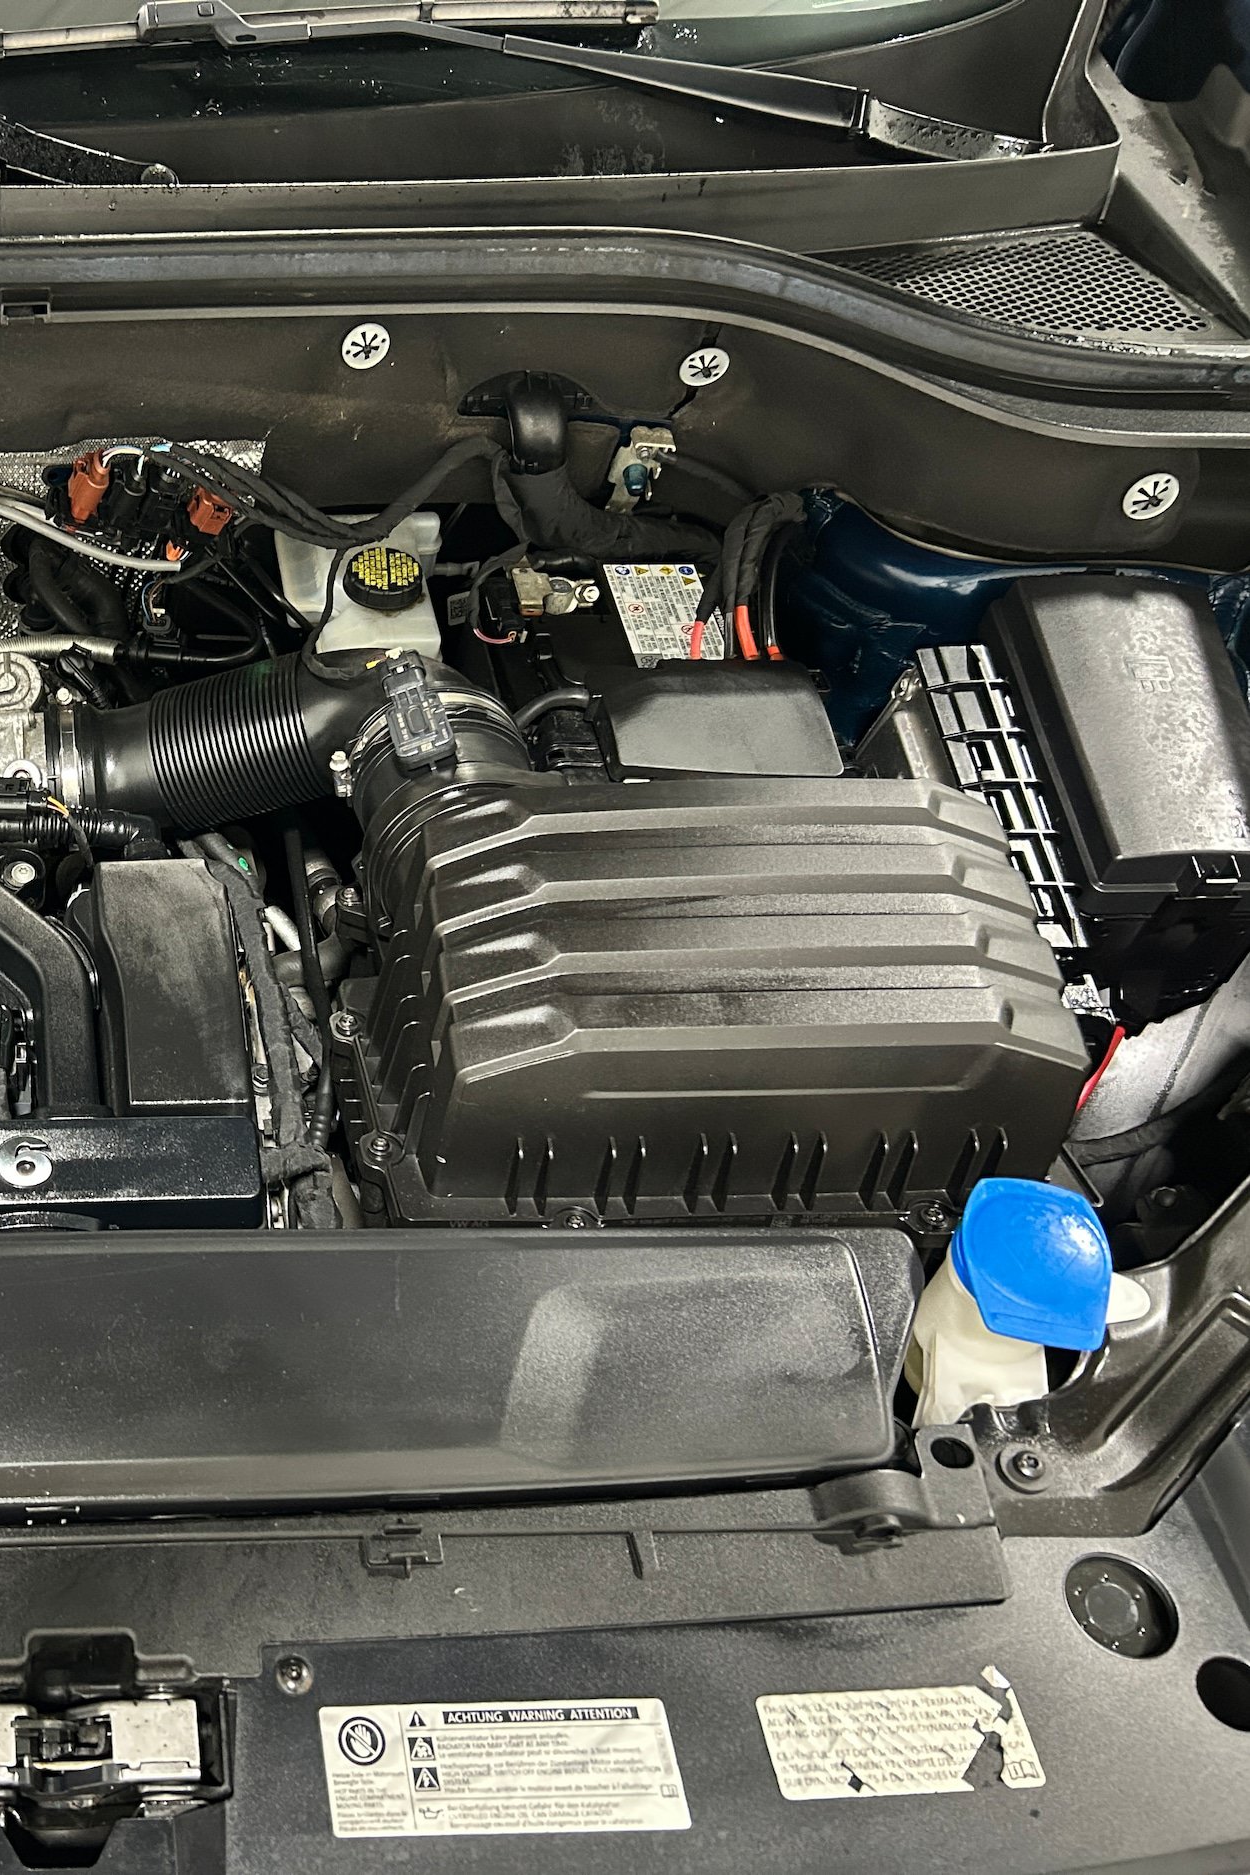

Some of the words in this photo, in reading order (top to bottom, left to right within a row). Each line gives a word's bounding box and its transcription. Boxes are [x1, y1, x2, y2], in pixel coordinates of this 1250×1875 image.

[447, 1711, 503, 1723] ACHTUNG
[508, 1709, 565, 1722] WARNING
[569, 1707, 633, 1721] ATTENTION
